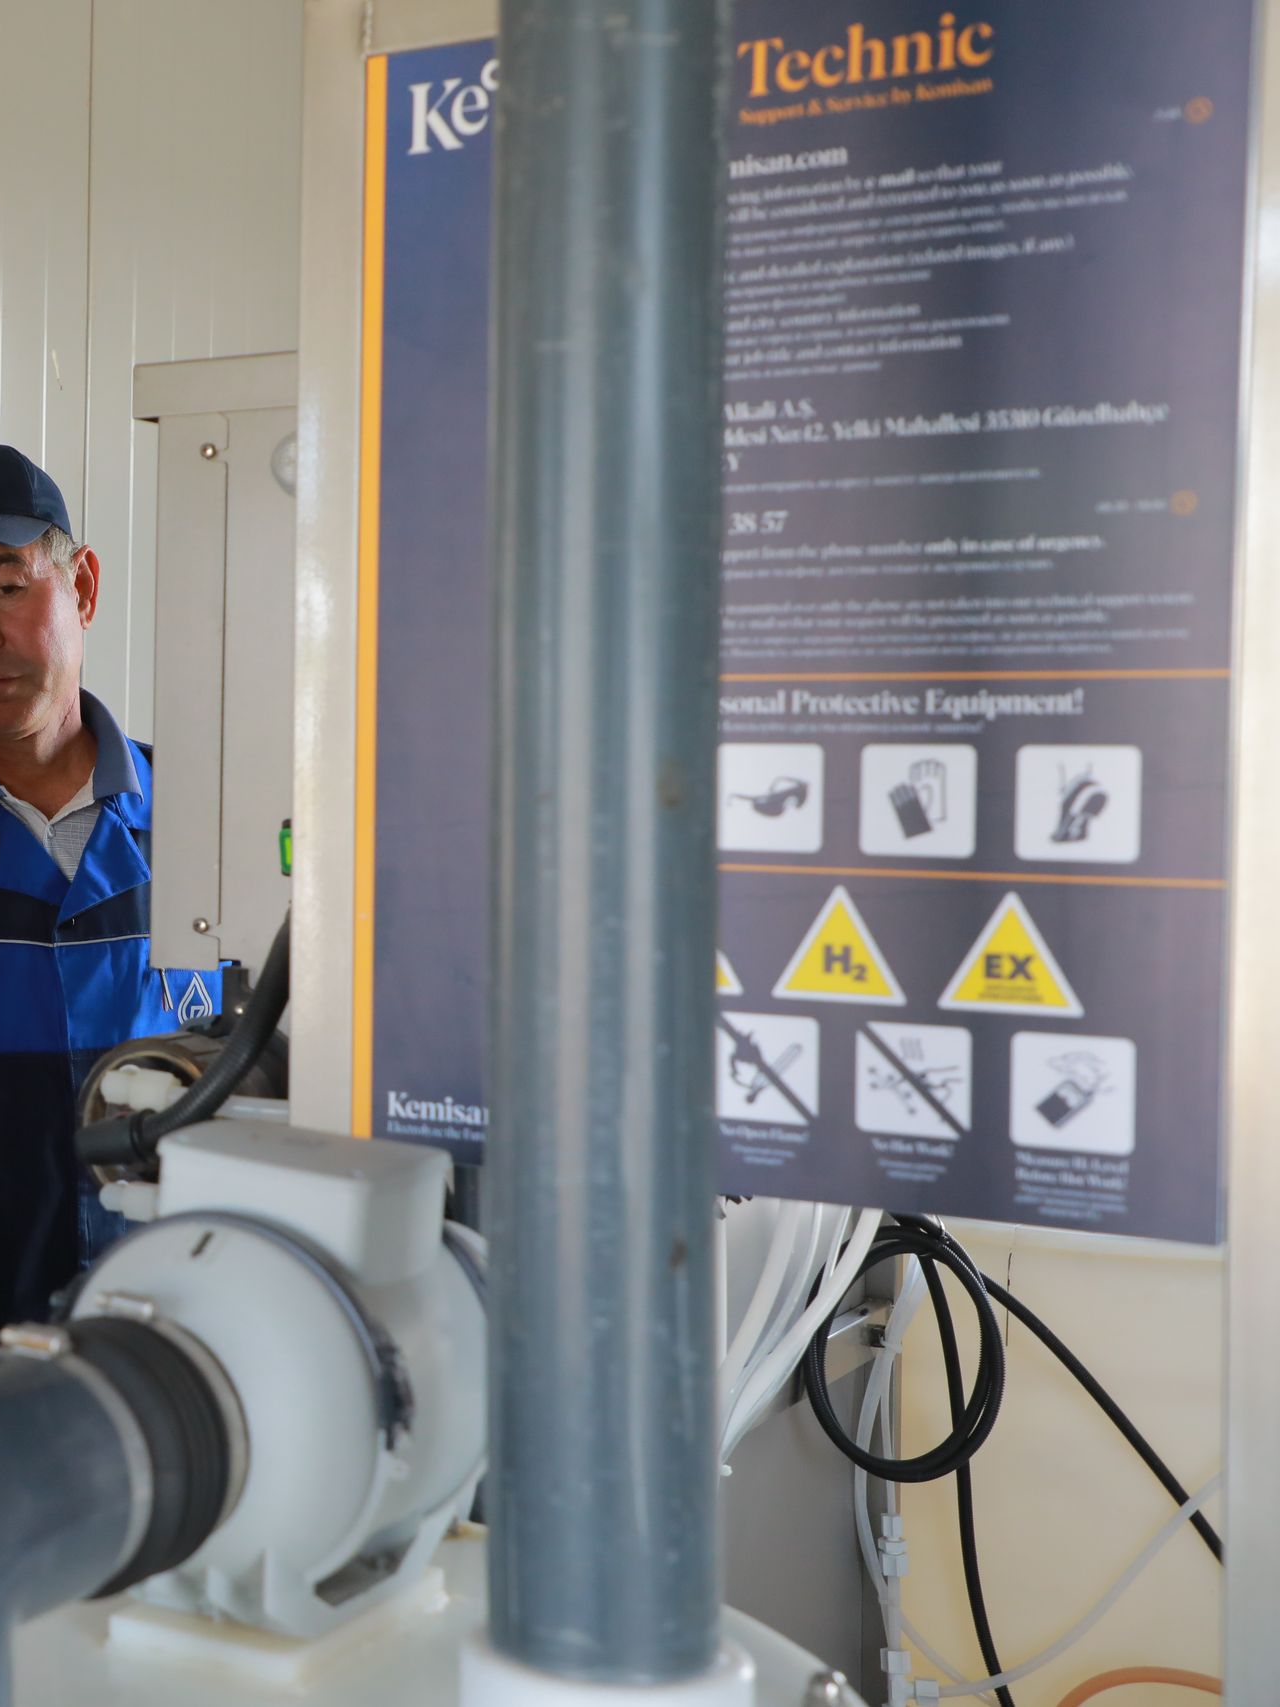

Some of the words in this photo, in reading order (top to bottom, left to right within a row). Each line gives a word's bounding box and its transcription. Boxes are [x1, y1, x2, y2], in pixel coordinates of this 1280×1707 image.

[736, 11, 994, 98] Technic
[728, 511, 758, 537] 38
[760, 509, 789, 535] 57
[791, 688, 919, 716] Protective
[924, 686, 1084, 722] Equipment!
[983, 953, 1035, 981] EX
